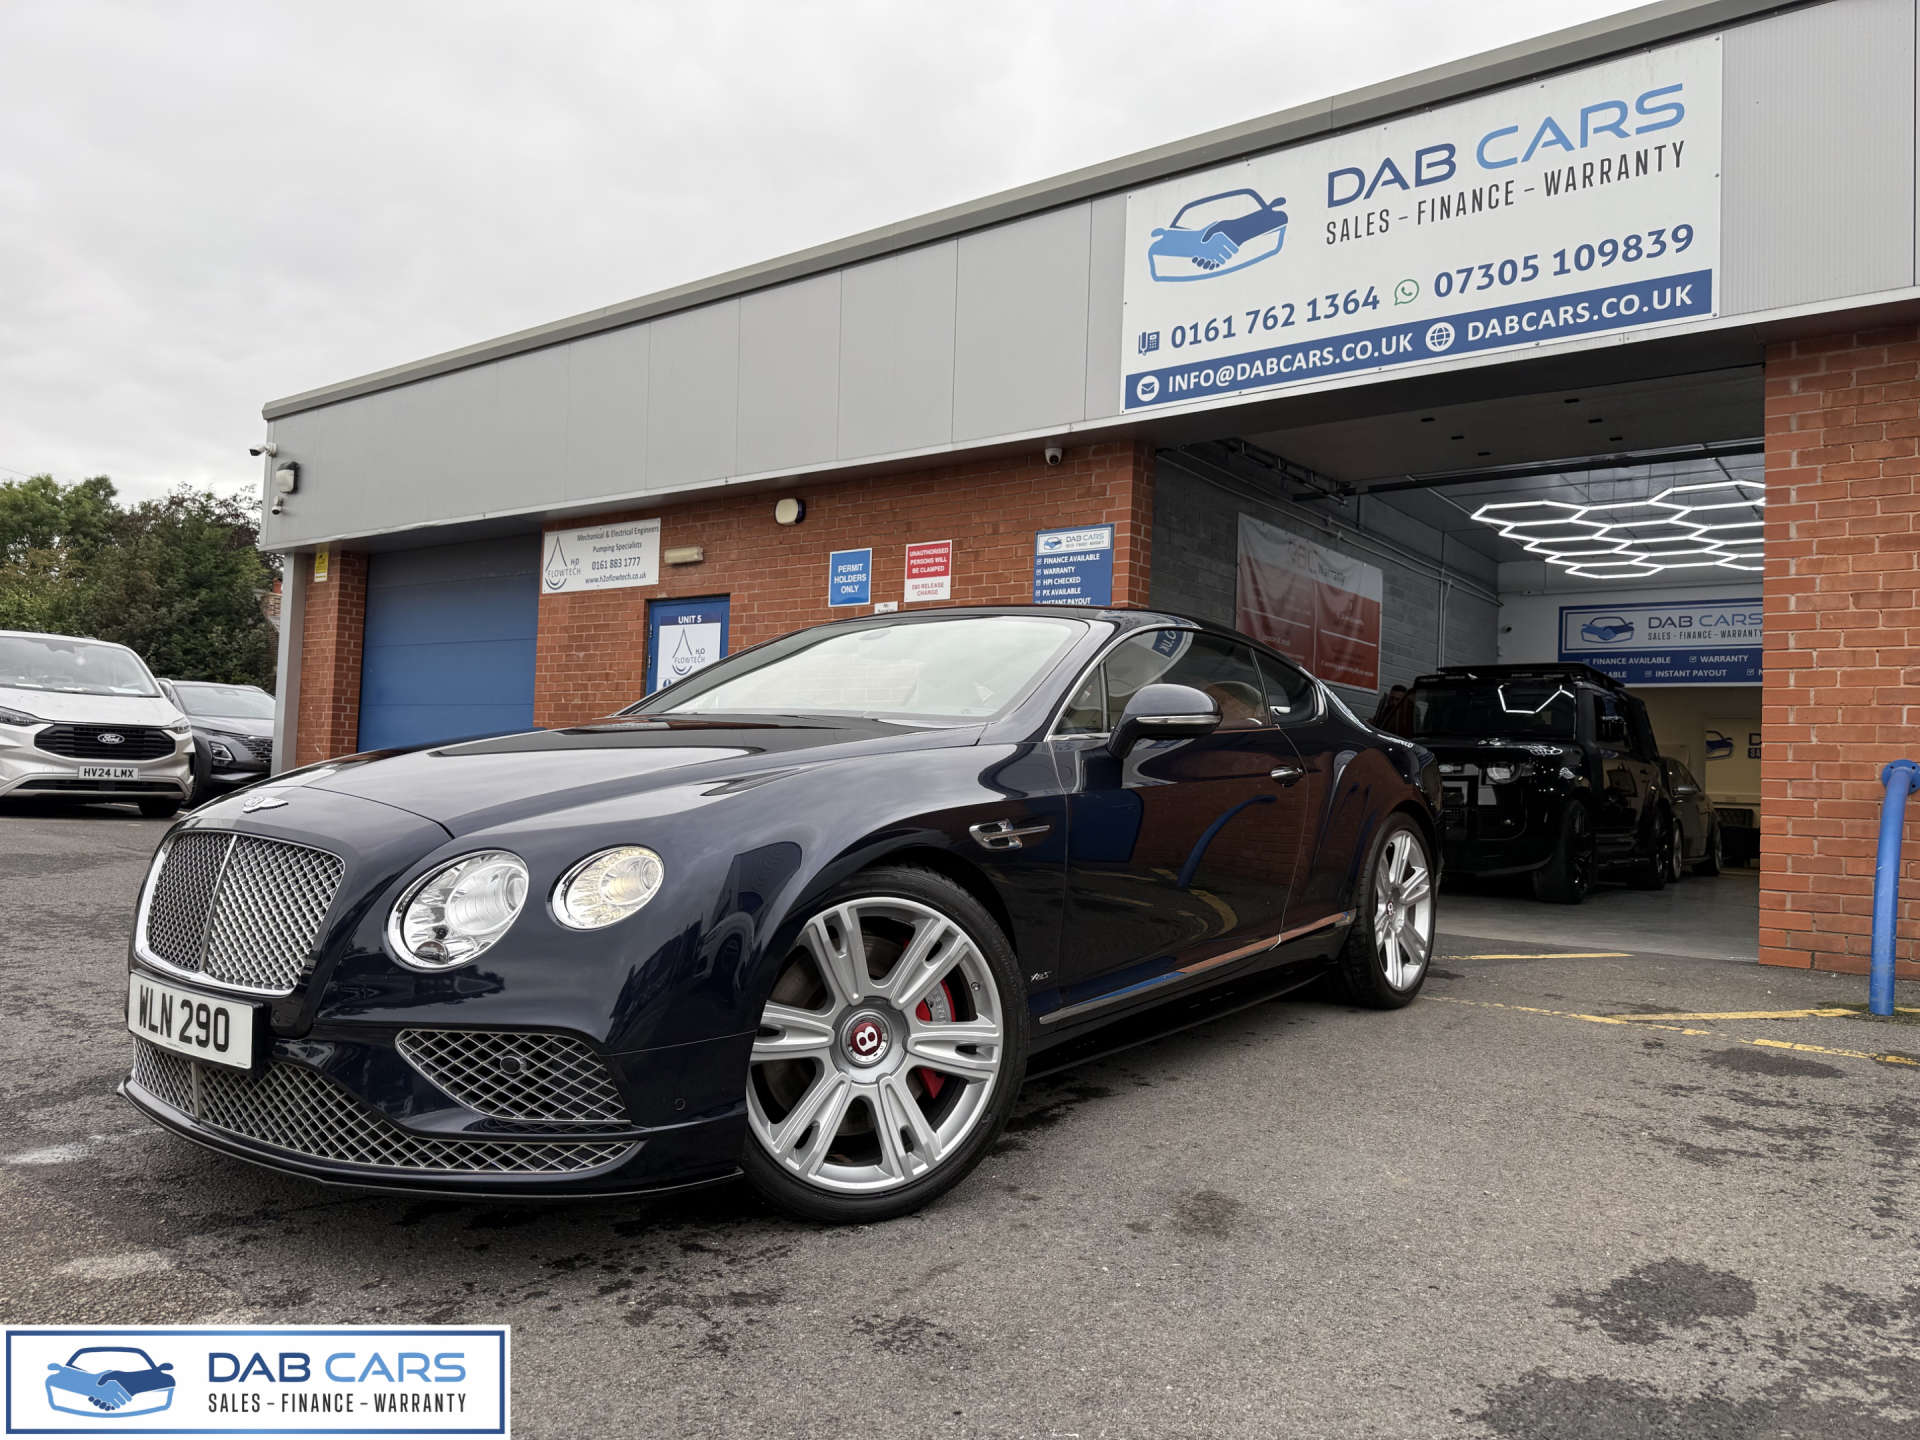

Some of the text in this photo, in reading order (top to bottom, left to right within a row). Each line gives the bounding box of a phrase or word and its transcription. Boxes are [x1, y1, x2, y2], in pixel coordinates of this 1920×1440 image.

[1327, 83, 1685, 208] DAB CARS
[1326, 208, 1390, 245] SALES
[1417, 180, 1515, 226] FINANCE
[1544, 140, 1685, 198] WARRANTY
[1433, 223, 1695, 298] 07305 109839
[1170, 286, 1380, 349] 0161 762 1364
[1467, 284, 1693, 342] DABCARS.CO.UK
[1168, 332, 1413, 393] INFO@DABCARS.CO.UK
[577, 532, 604, 542] Mechanical
[611, 529, 633, 538] Electrical
[1065, 535, 1082, 543] DAB
[592, 541, 642, 554] Pumping Specialists
[592, 556, 640, 571] 0161 883 1777
[1043, 553, 1100, 565] FINANCE AVAILABLE
[548, 567, 581, 578] FLOWTECH
[838, 563, 863, 574] PERMIT
[1043, 566, 1075, 575] WARRANTY
[834, 573, 867, 584] HOLDERS
[1043, 576, 1081, 586] HPI CHECKED
[840, 585, 859, 595] ONLY
[1042, 587, 1081, 597] PX AVAILABLE
[1067, 597, 1092, 605] PAYOUT
[678, 615, 703, 624] UNIT 5
[1648, 613, 1763, 630] DAB CARS
[1648, 631, 1671, 641] SALES
[1679, 630, 1712, 640] FINANCE
[1720, 628, 1763, 639] WARRANTY
[674, 655, 706, 664] FLOWTECH
[1592, 656, 1671, 665] FINANCE AVAILABLE
[1700, 655, 1748, 664] WARRANTY
[1655, 669, 1728, 678] INSTANT PAYOUT
[103, 734, 120, 744] Ford
[83, 767, 111, 777] HV24
[139, 984, 230, 1052] WLN 290
[856, 1026, 878, 1053] B
